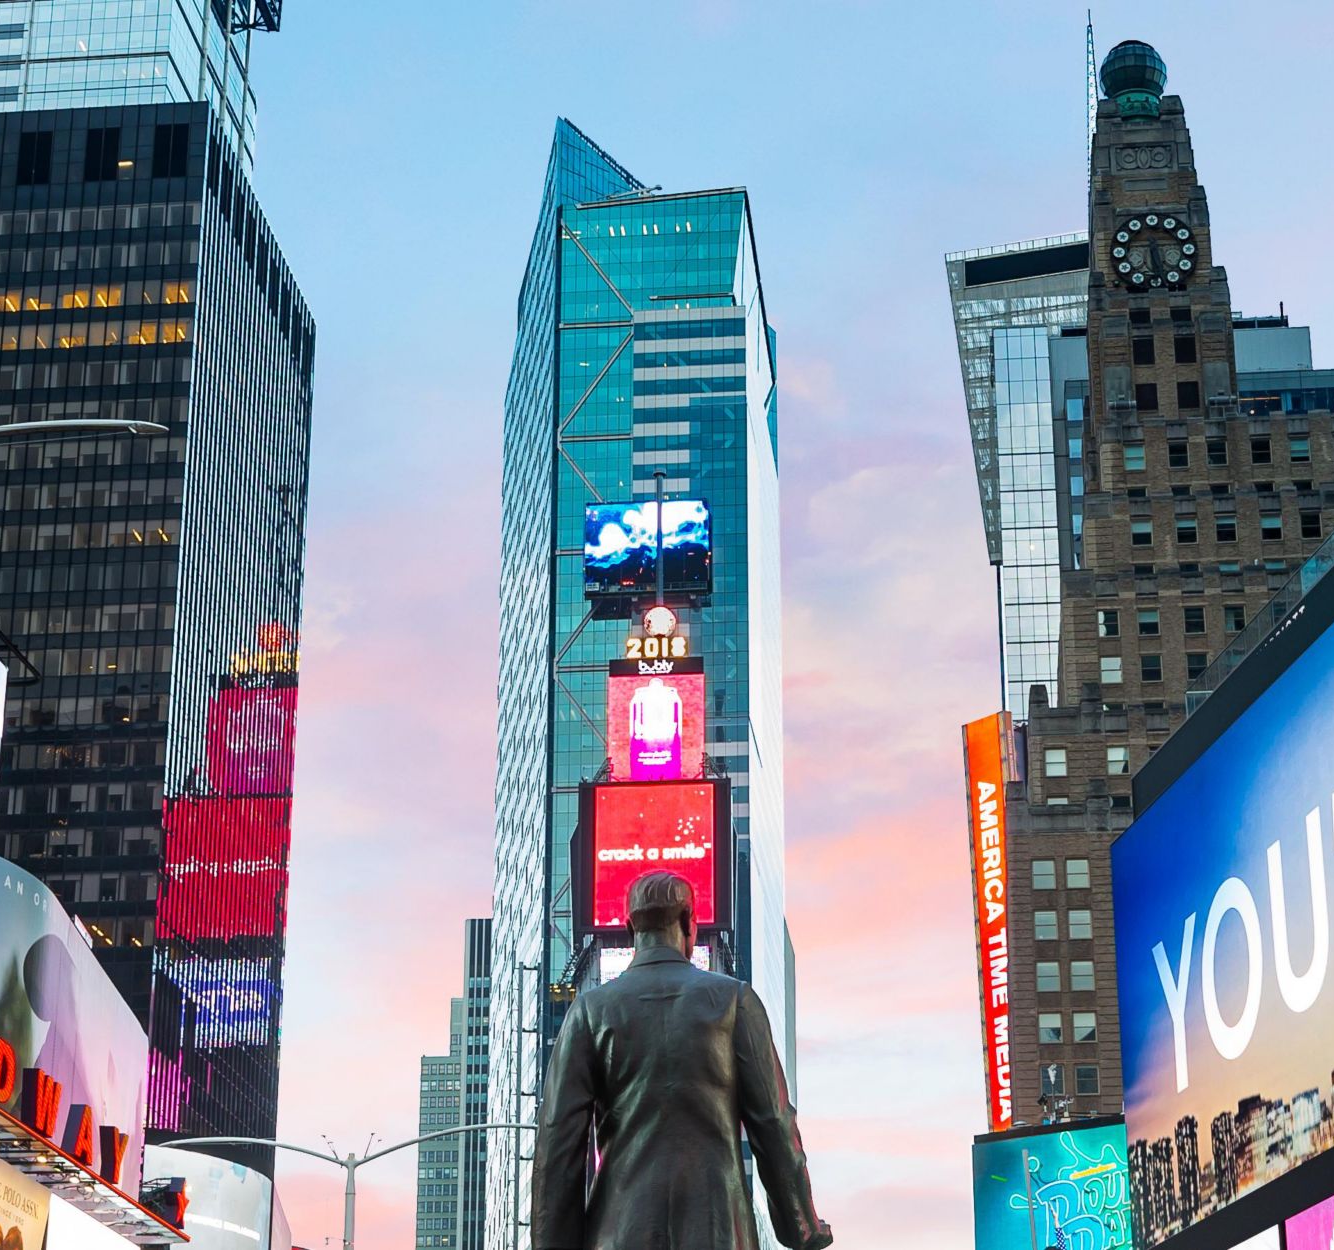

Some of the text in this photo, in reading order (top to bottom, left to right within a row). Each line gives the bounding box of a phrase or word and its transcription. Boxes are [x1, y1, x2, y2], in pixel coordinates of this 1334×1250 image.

[626, 636, 687, 659] 2018
[598, 843, 644, 862] crack
[646, 848, 659, 861] a
[4, 875, 24, 896] AN
[976, 781, 1013, 1122] AMERICA TIME MEDIA
[2, 1185, 21, 1208] POLO
